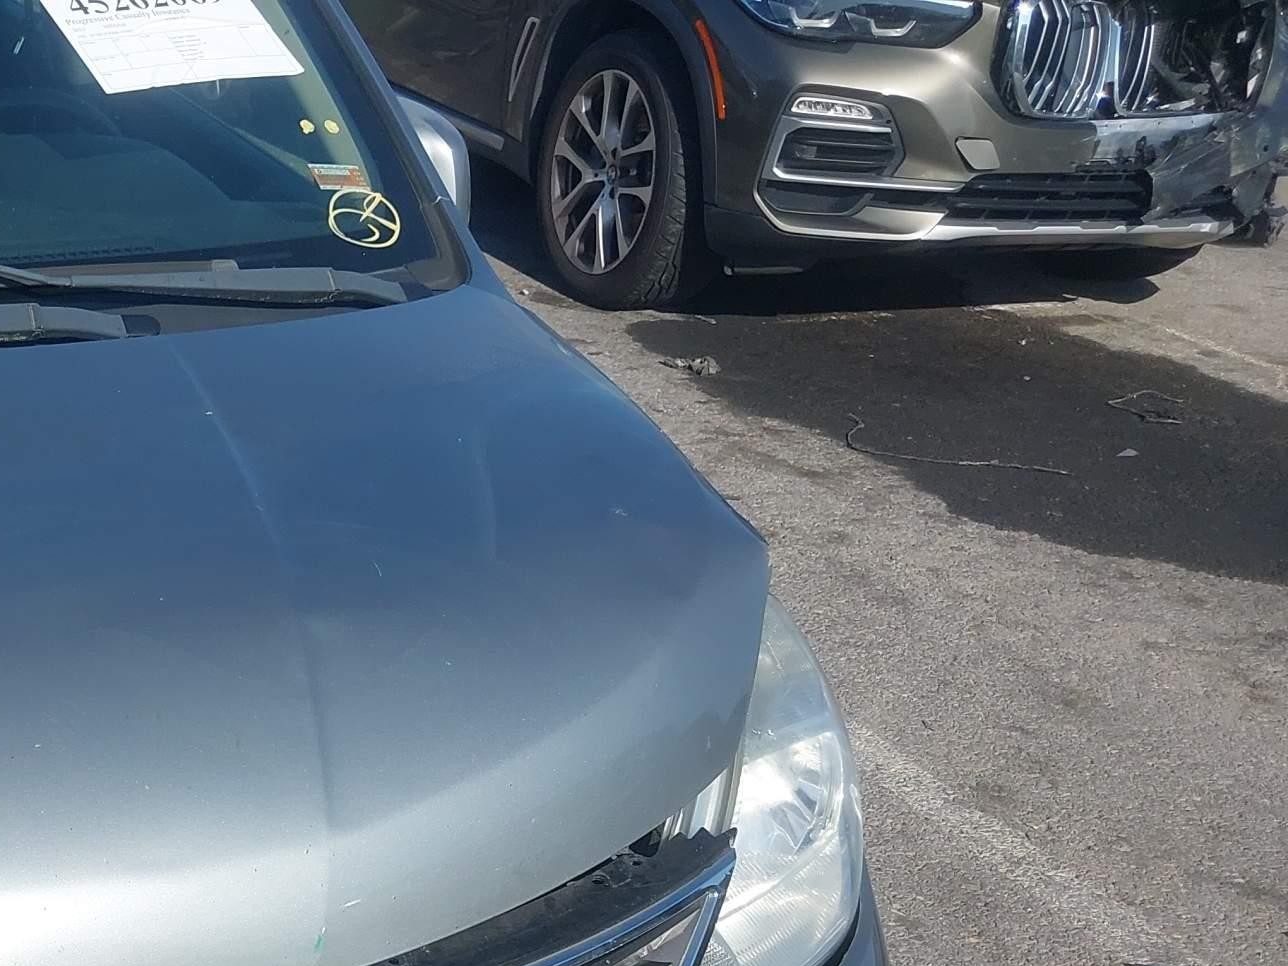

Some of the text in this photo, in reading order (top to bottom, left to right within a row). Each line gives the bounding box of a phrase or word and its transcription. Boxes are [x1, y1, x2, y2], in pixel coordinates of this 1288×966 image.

[65, 15, 114, 26] Progressive
[115, 10, 151, 21] Casualty
[152, 8, 191, 18] Insurance
